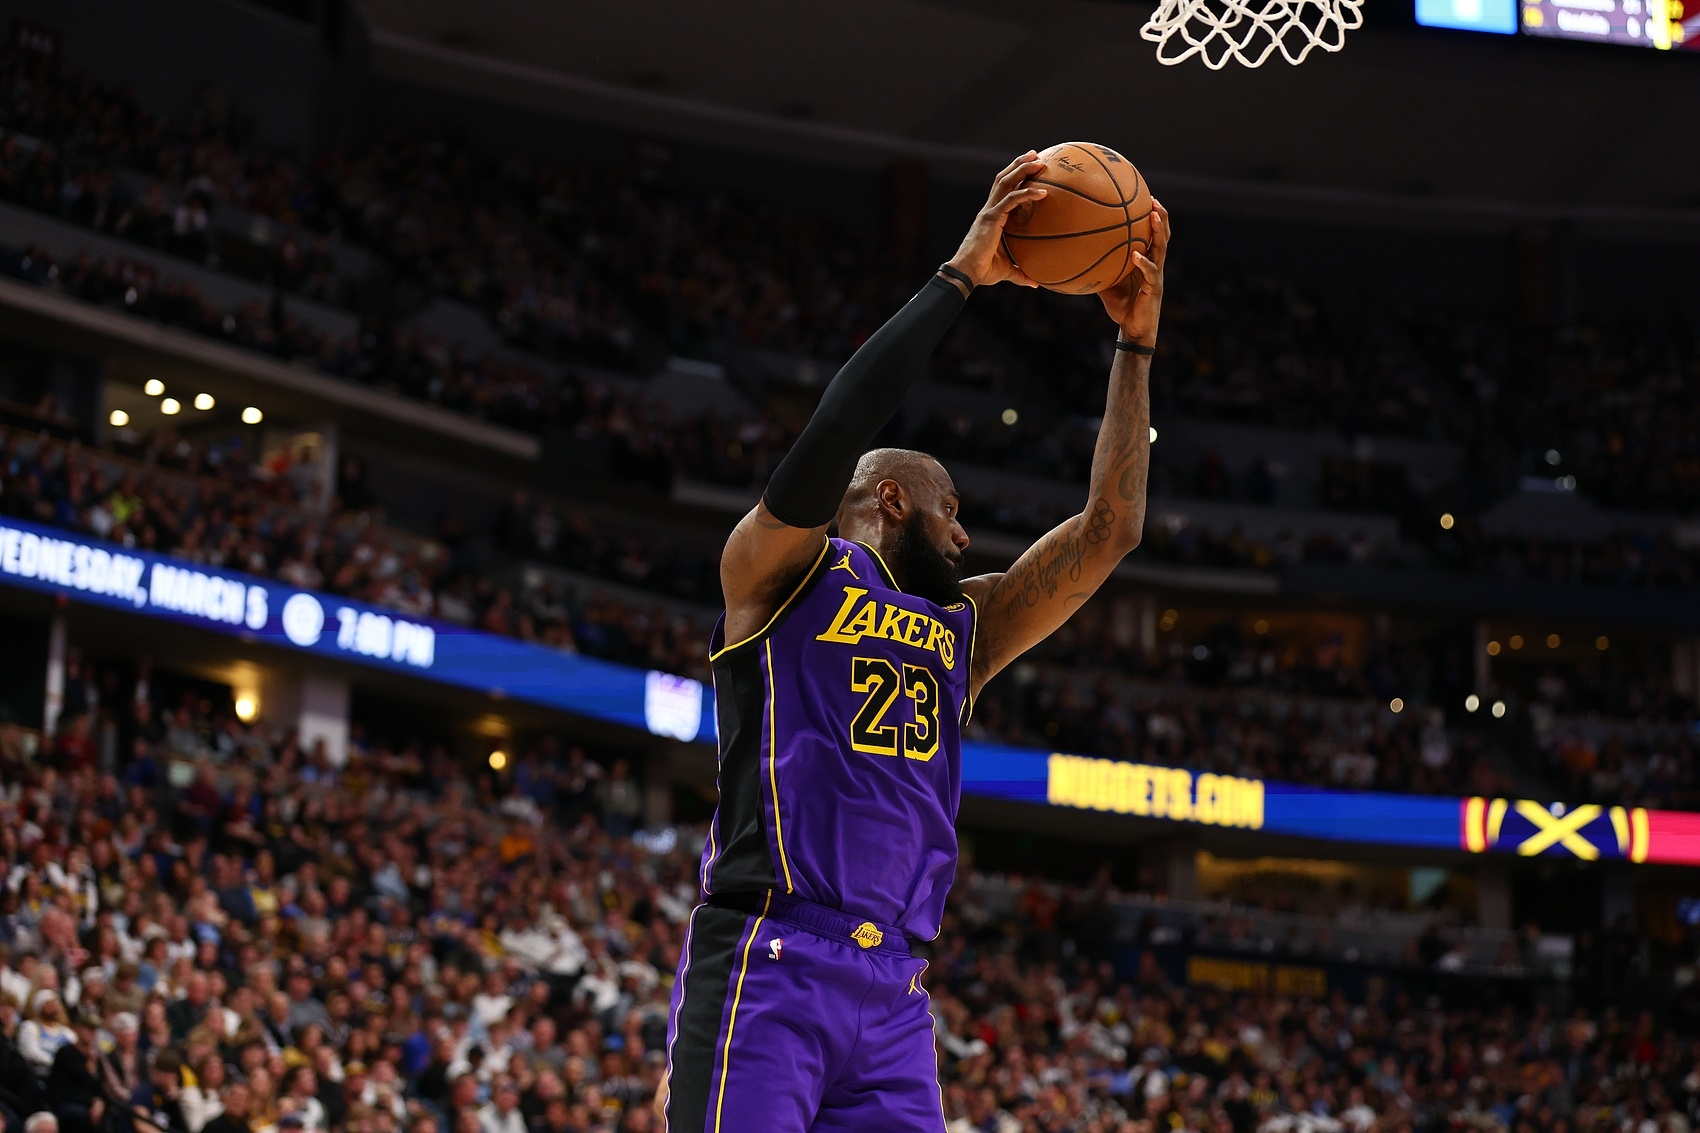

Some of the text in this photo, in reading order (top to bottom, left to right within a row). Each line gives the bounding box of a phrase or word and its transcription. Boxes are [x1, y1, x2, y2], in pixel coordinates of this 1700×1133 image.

[0, 526, 148, 608] EDNESDAY,
[149, 563, 246, 625] MARCH
[246, 585, 268, 630] 5
[391, 620, 435, 668] PM
[816, 586, 956, 671] LAKERS
[850, 656, 940, 762] 23
[1047, 753, 1265, 830] NUGGETS.COM
[853, 926, 881, 946] LAKERS
